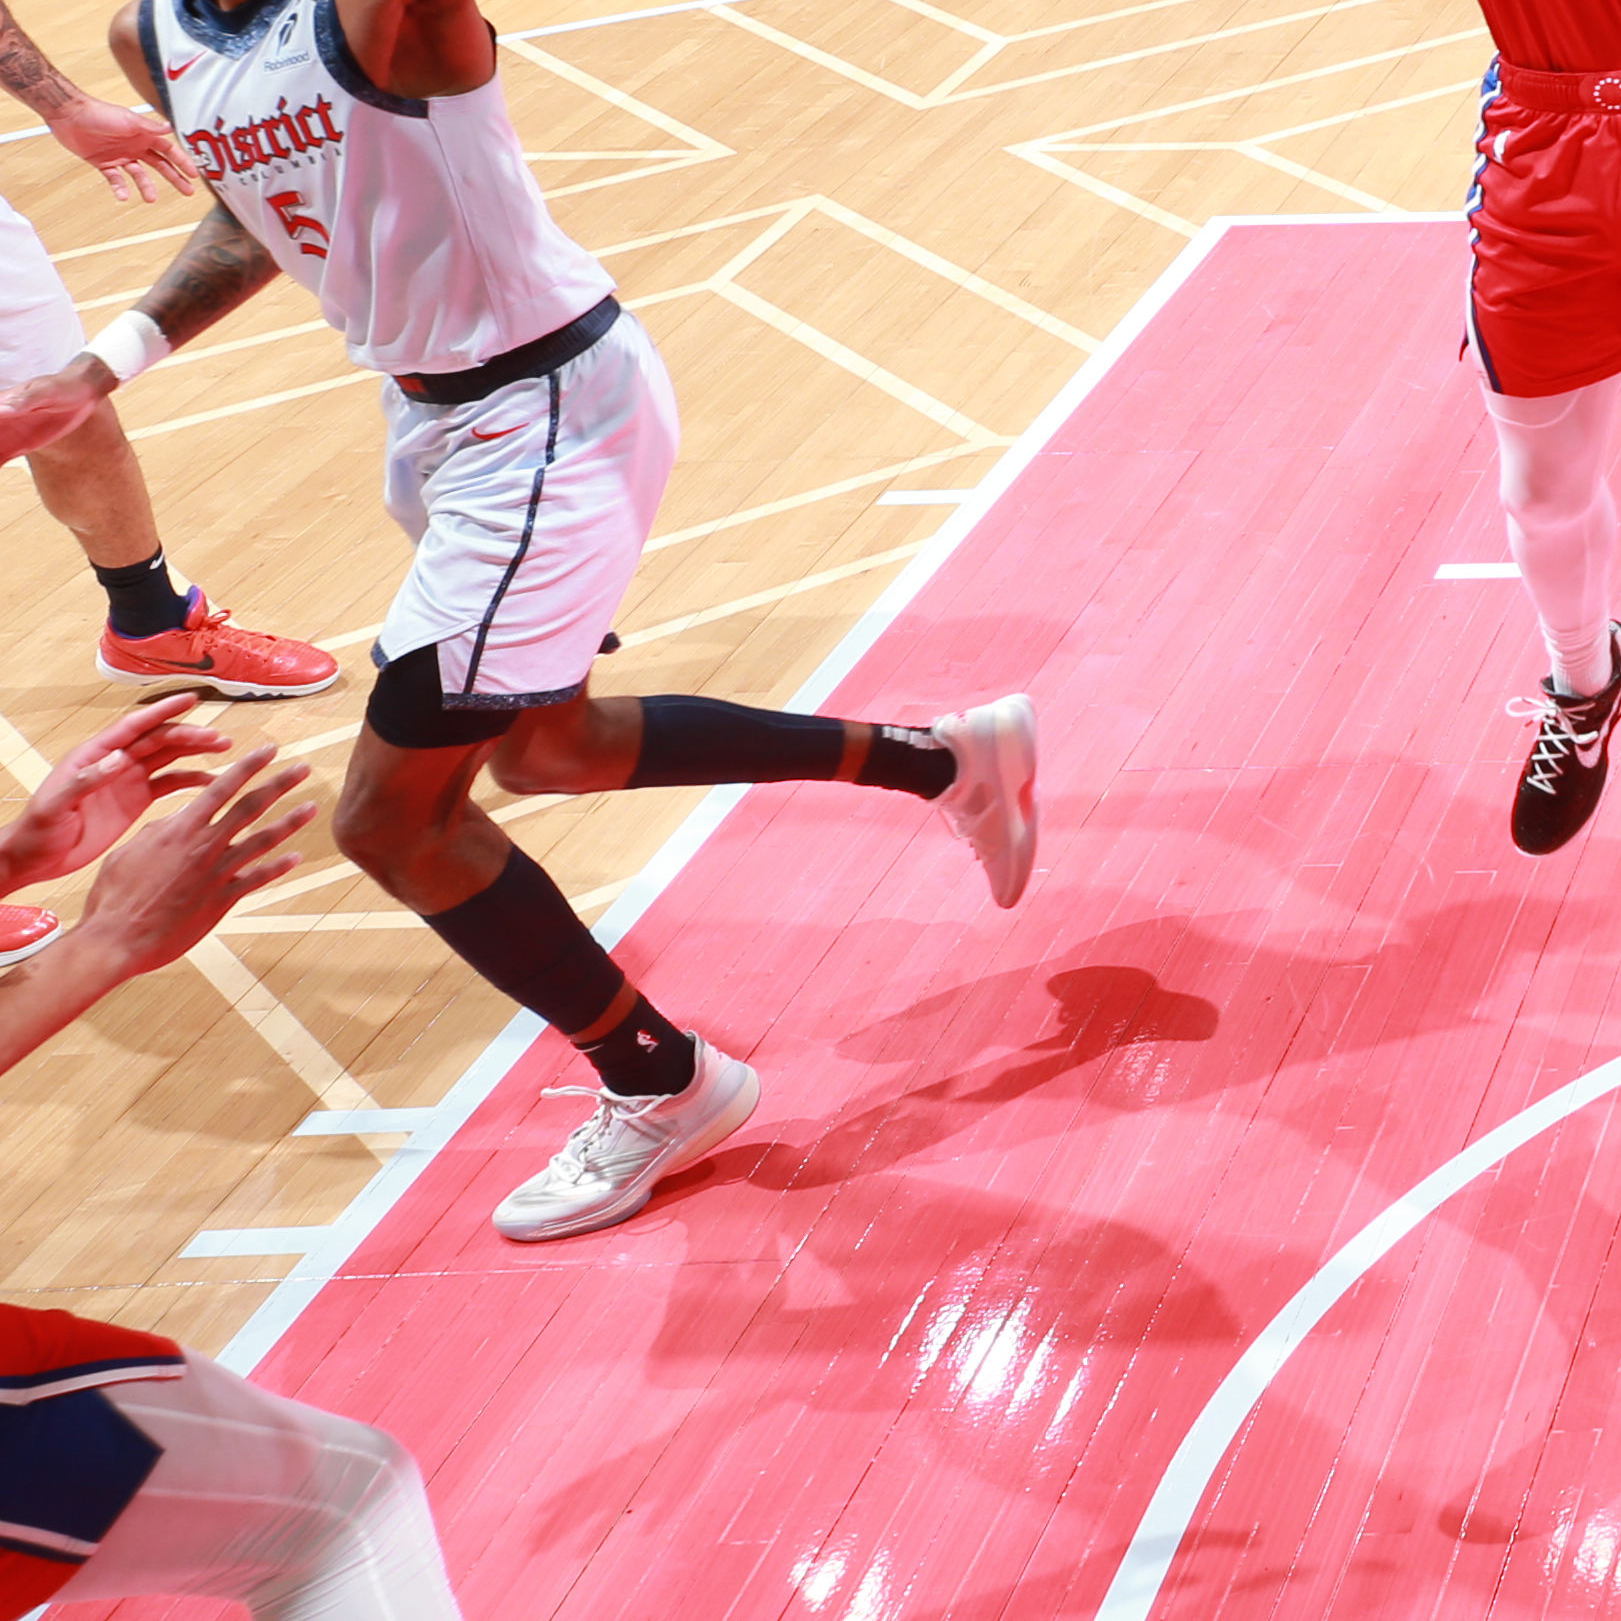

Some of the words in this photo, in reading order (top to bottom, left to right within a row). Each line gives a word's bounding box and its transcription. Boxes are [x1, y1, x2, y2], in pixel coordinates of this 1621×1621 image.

[182, 92, 345, 182] District
[238, 145, 343, 187] COLUMBIA
[265, 189, 332, 260] 5
